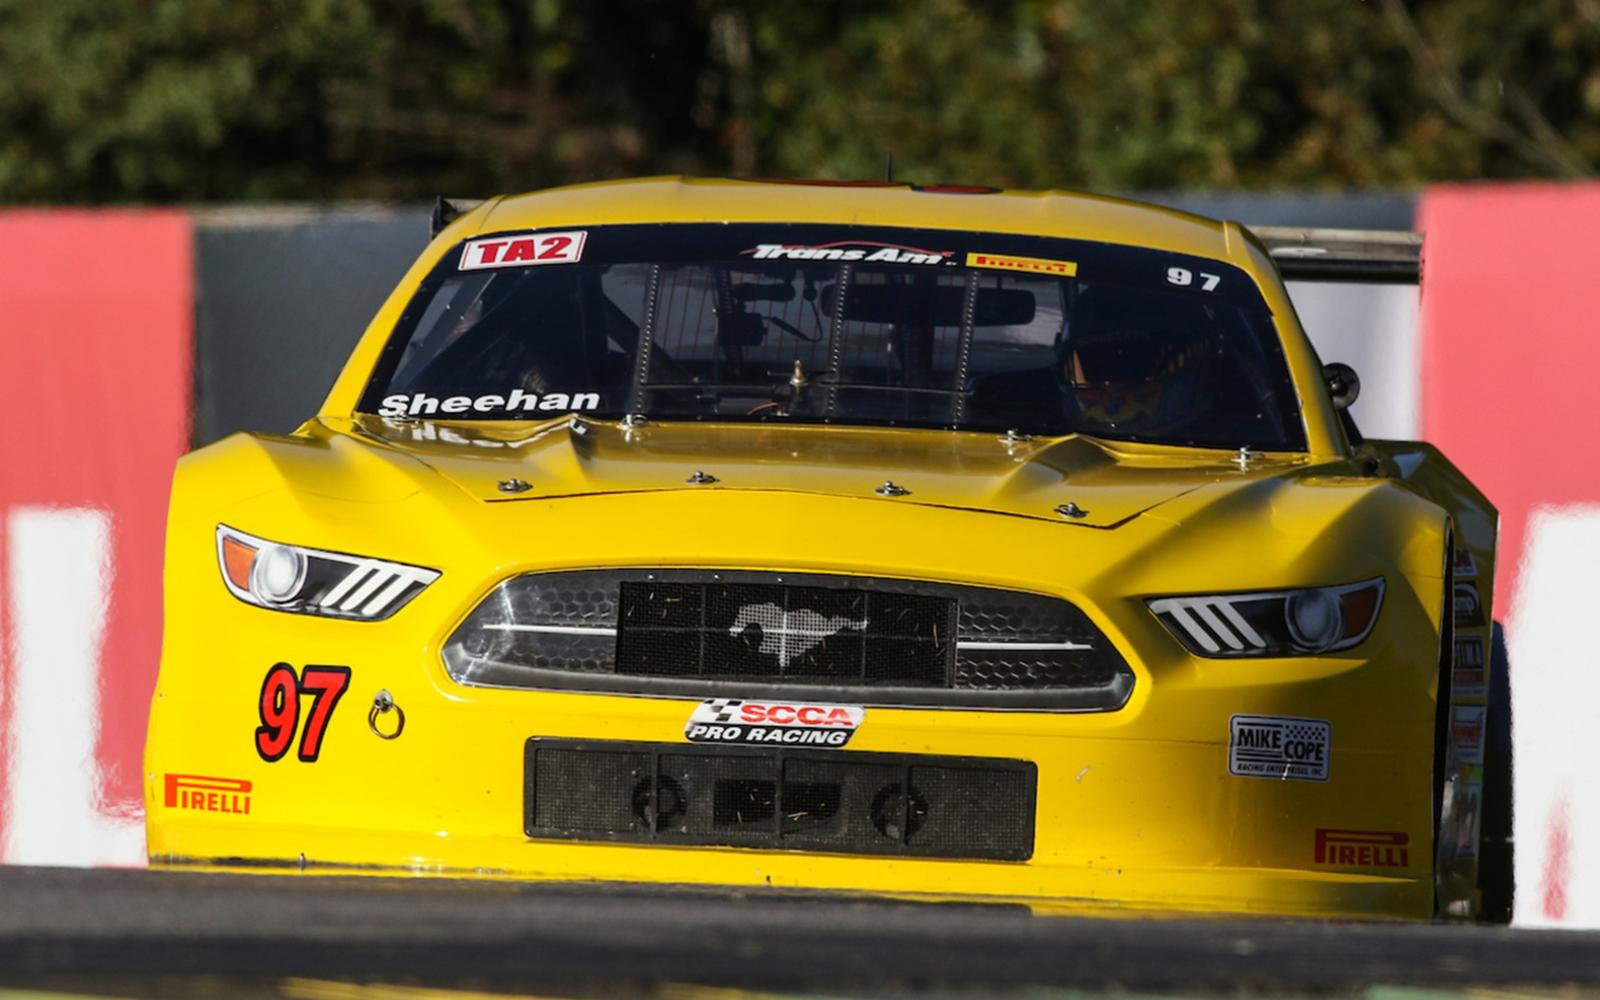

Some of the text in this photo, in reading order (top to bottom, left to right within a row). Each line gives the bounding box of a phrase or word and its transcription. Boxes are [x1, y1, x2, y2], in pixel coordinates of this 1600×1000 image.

[477, 236, 572, 264] TA2
[752, 244, 944, 265] Trans Am
[1166, 267, 1221, 292] 97
[378, 389, 601, 417] Sheehan
[255, 662, 352, 763] 97
[740, 704, 854, 727] SCCA
[688, 726, 848, 745] PRO RACING
[1237, 728, 1281, 749] MIKE
[1284, 740, 1324, 761] COPE
[164, 773, 252, 815] PIRELLI
[1314, 828, 1409, 868] PIRELLI
